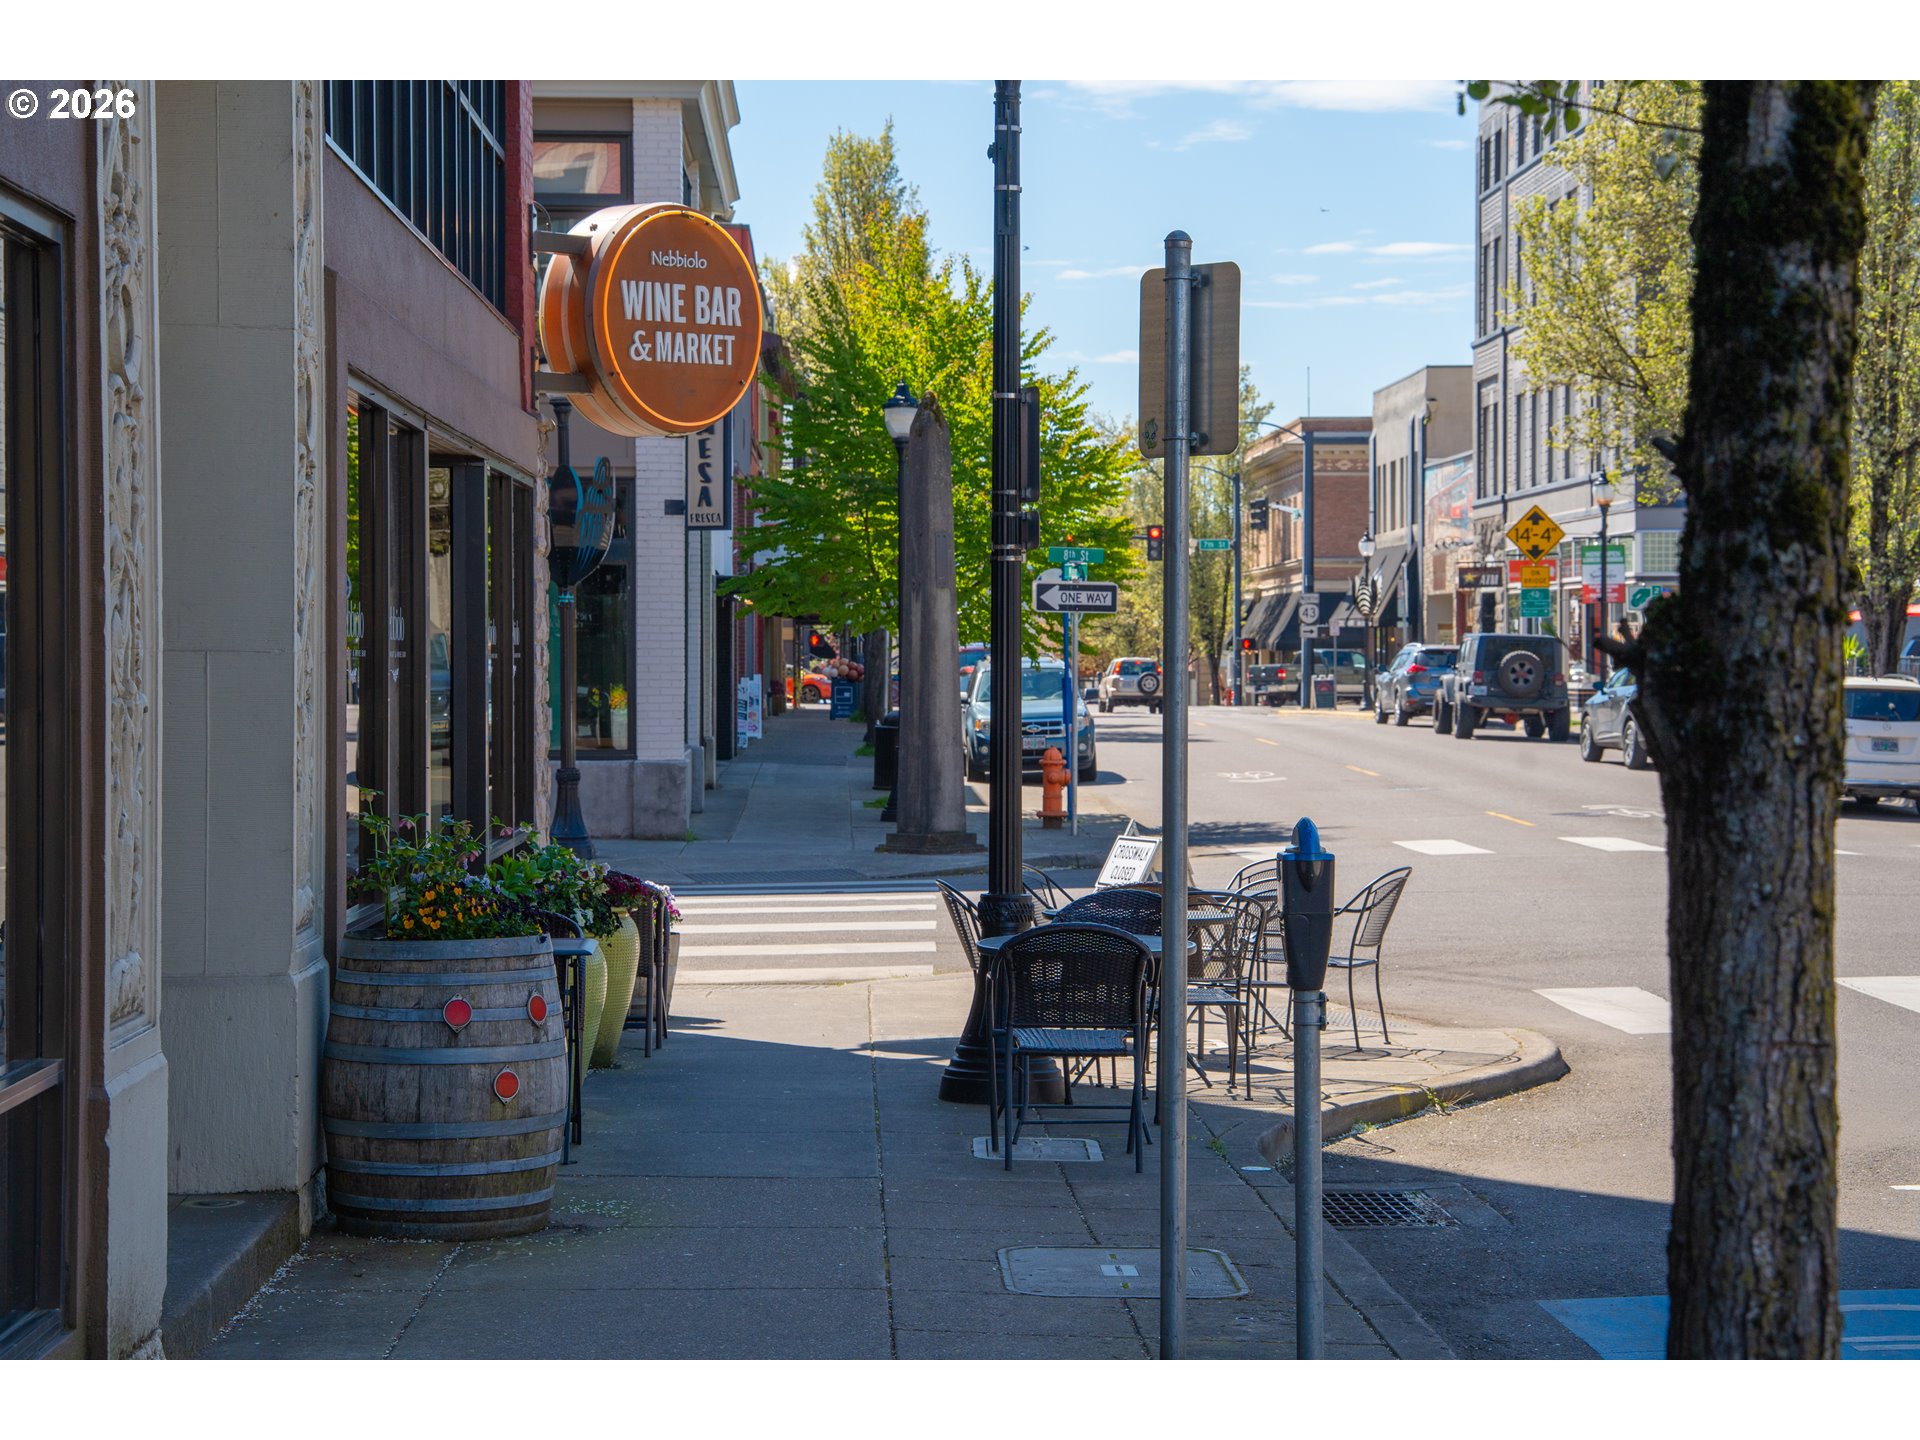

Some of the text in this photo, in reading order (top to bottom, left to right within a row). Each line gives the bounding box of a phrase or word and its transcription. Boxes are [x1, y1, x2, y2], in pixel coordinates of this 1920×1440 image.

[651, 250, 708, 269] Nebbiolo
[621, 280, 742, 327] WINE BAR
[629, 330, 736, 366] & MARKET
[689, 512, 722, 524] FRESCA
[1063, 549, 1089, 562] 8th St
[1479, 573, 1500, 585] ATM
[1060, 592, 1109, 604] ONE WAY
[1302, 607, 1316, 618] 43
